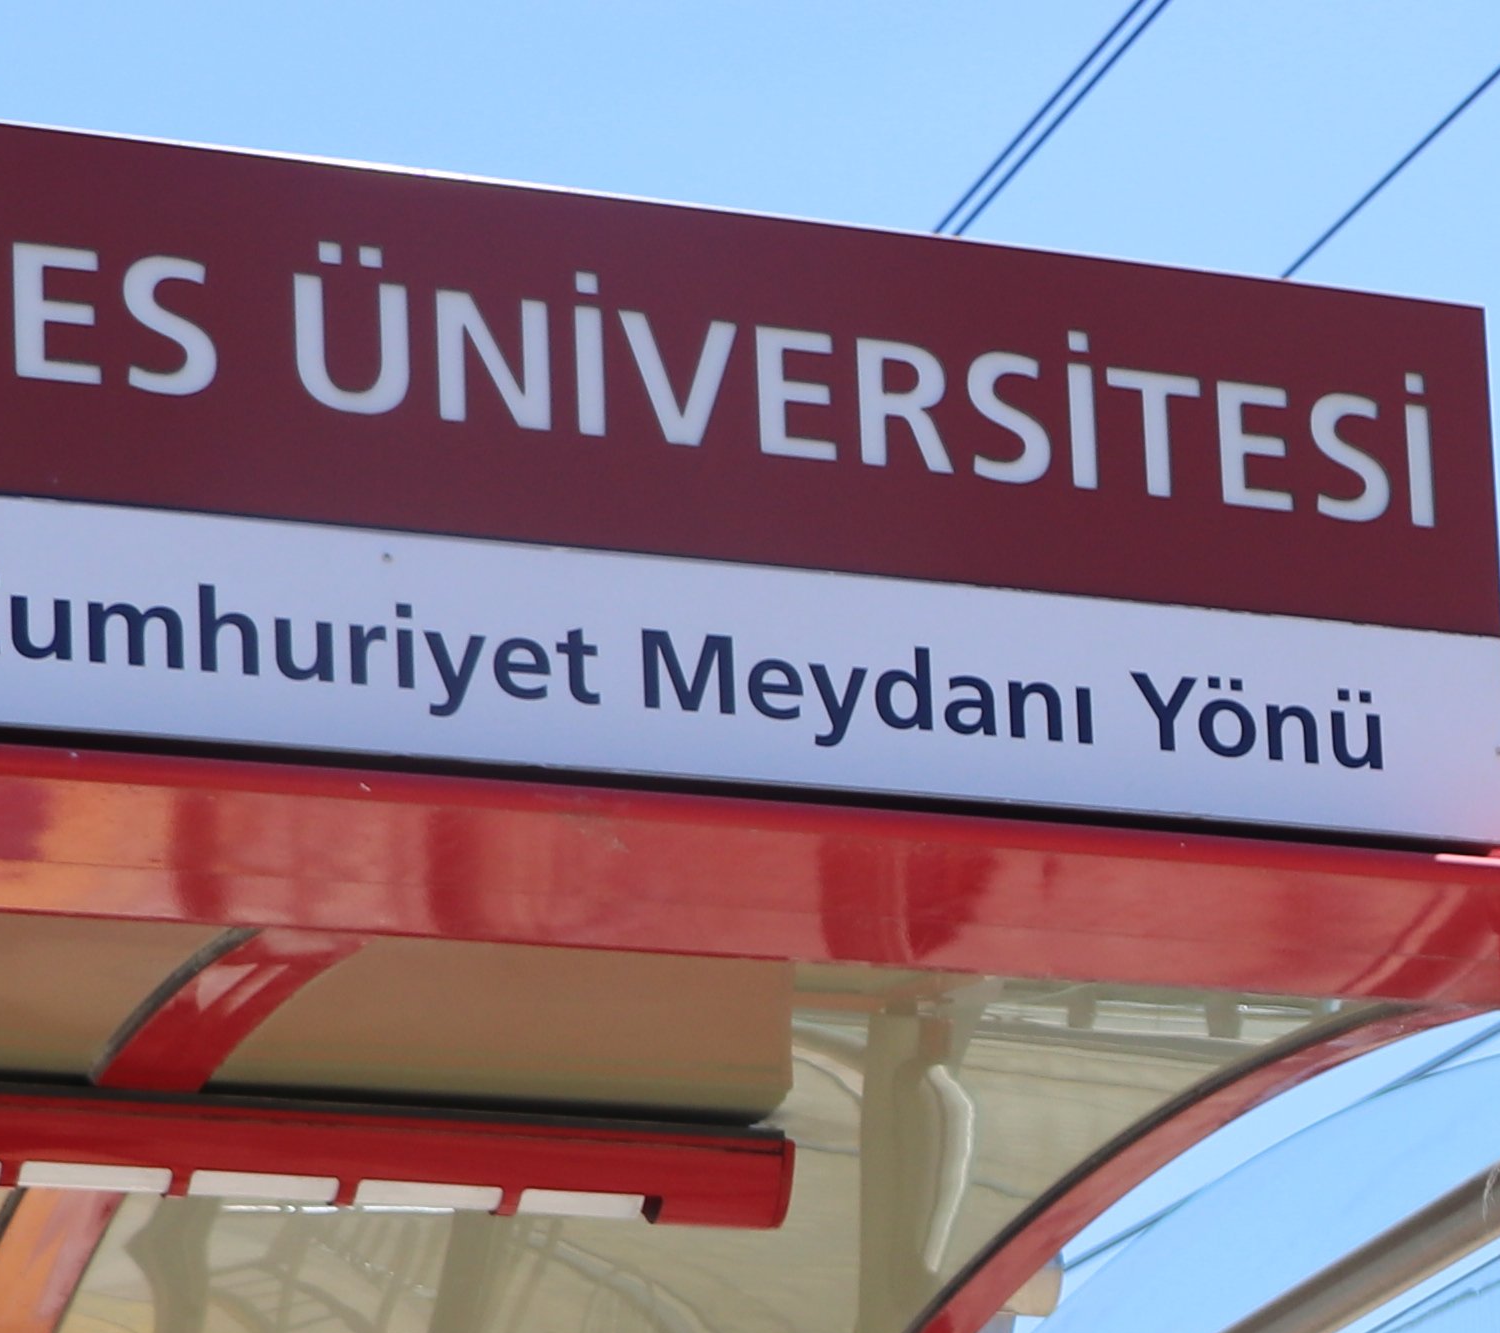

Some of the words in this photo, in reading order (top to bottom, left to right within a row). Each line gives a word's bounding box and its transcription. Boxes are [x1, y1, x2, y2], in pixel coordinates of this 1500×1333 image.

[293, 241, 1435, 528] ÜNİVERSİTESİ
[641, 628, 1094, 748] Meydanı
[1130, 671, 1384, 771] Yönü
